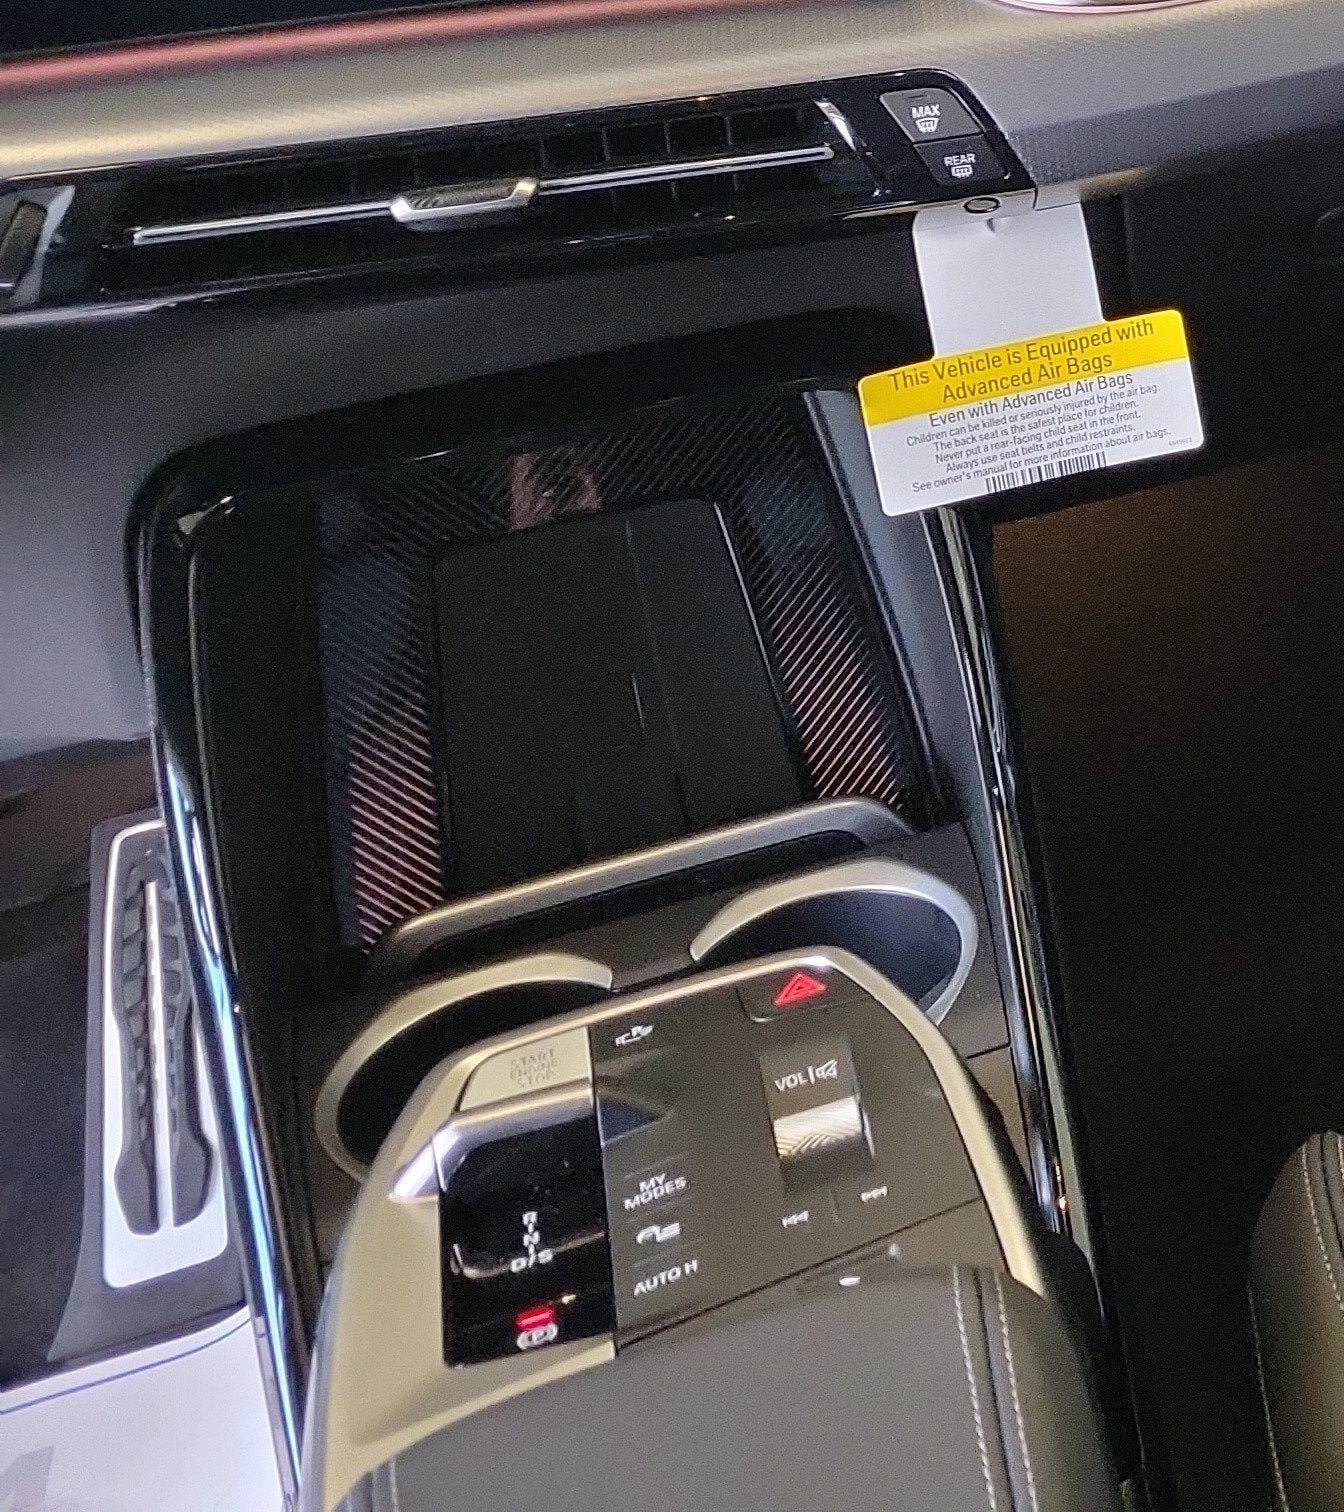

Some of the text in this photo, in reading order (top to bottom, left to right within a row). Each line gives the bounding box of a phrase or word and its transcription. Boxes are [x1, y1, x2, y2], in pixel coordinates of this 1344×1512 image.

[911, 103, 941, 119] MAX
[943, 153, 977, 167] REAR
[889, 319, 1154, 391] This Vehicle is Equipped with
[943, 354, 1113, 403] Advanced Air Bags
[906, 383, 1161, 447] Children can be killed or seriously injured by the air bag.
[929, 373, 1133, 428] Even with Advanced Air Bags
[933, 400, 1139, 452] The back seat is the safest place for children.
[935, 410, 1142, 464] Never put a rear-facing child seat in the front.
[946, 422, 1136, 473] Always use seat belts and child restraints.
[912, 426, 1171, 493] See owner's manual for more information about air bags.
[774, 1072, 809, 1092] VOL
[623, 1176, 687, 1211] MODES
[639, 1173, 666, 1193] MY
[633, 1259, 698, 1297] AUTO H
